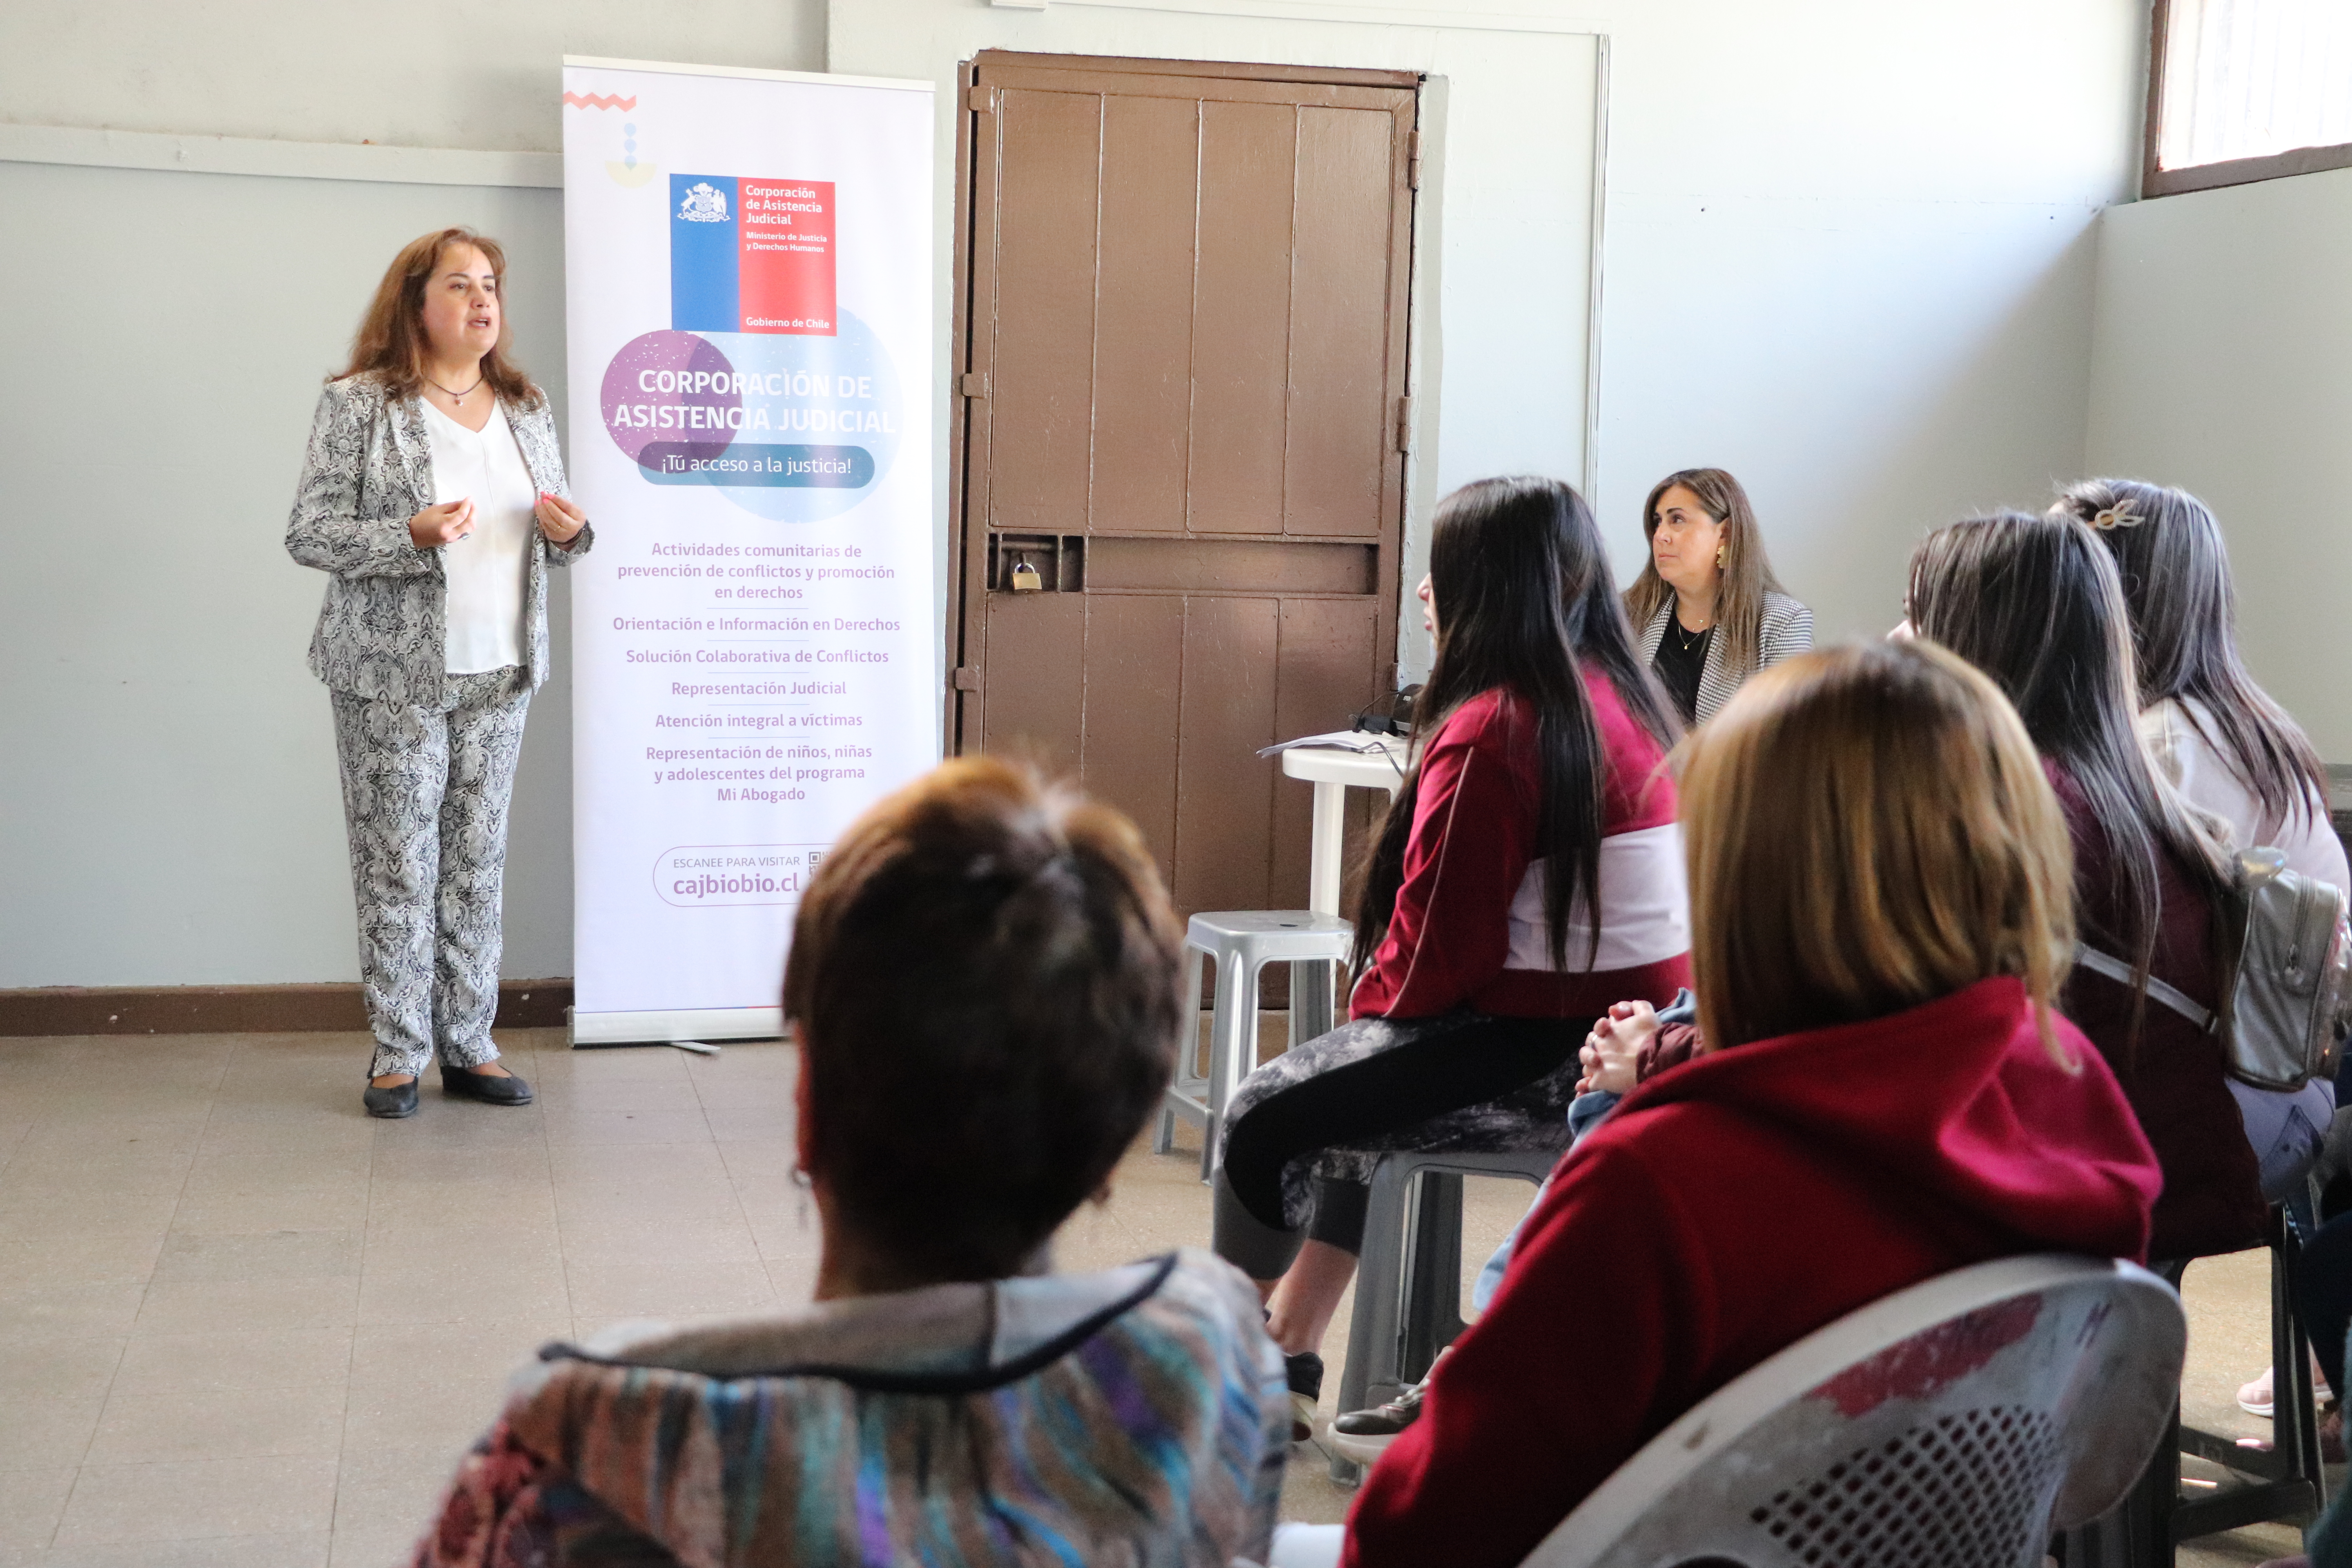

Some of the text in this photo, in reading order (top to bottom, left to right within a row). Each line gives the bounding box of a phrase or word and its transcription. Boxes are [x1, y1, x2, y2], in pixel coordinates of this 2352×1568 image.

[745, 185, 816, 199] Corporación
[746, 198, 822, 213] de Asistencia
[746, 212, 792, 225] Judicial
[746, 231, 786, 240] Ministerio
[798, 234, 827, 242] Justicia
[752, 242, 788, 251] Derechos
[789, 244, 824, 253] Humanos
[746, 316, 829, 328] Gobierno de Chile
[639, 370, 871, 398] CORPORACIÓN DE
[614, 405, 896, 433] ASISTENCIA JUDICIAL
[662, 454, 851, 475] ¡Tú acceso a la justicia!
[652, 542, 862, 558] Actividades comunitarias de
[618, 564, 895, 581] prevención de conflictos y promoción
[714, 585, 803, 599] en derechos
[613, 617, 900, 631] Orientación e Información en Derechos
[626, 649, 889, 663] Solución Colaborativa de Conflictos
[671, 681, 847, 698] Representación Judicial
[655, 713, 863, 730] Atención integral a víctimas
[646, 744, 872, 763] Representación de niños, niñas
[654, 766, 865, 784] y adolescentes del programa
[717, 787, 806, 804] Mi Abogado
[673, 856, 800, 868] ESCANEE PARA VISITAR
[673, 872, 799, 899] cajbiobio.cl
